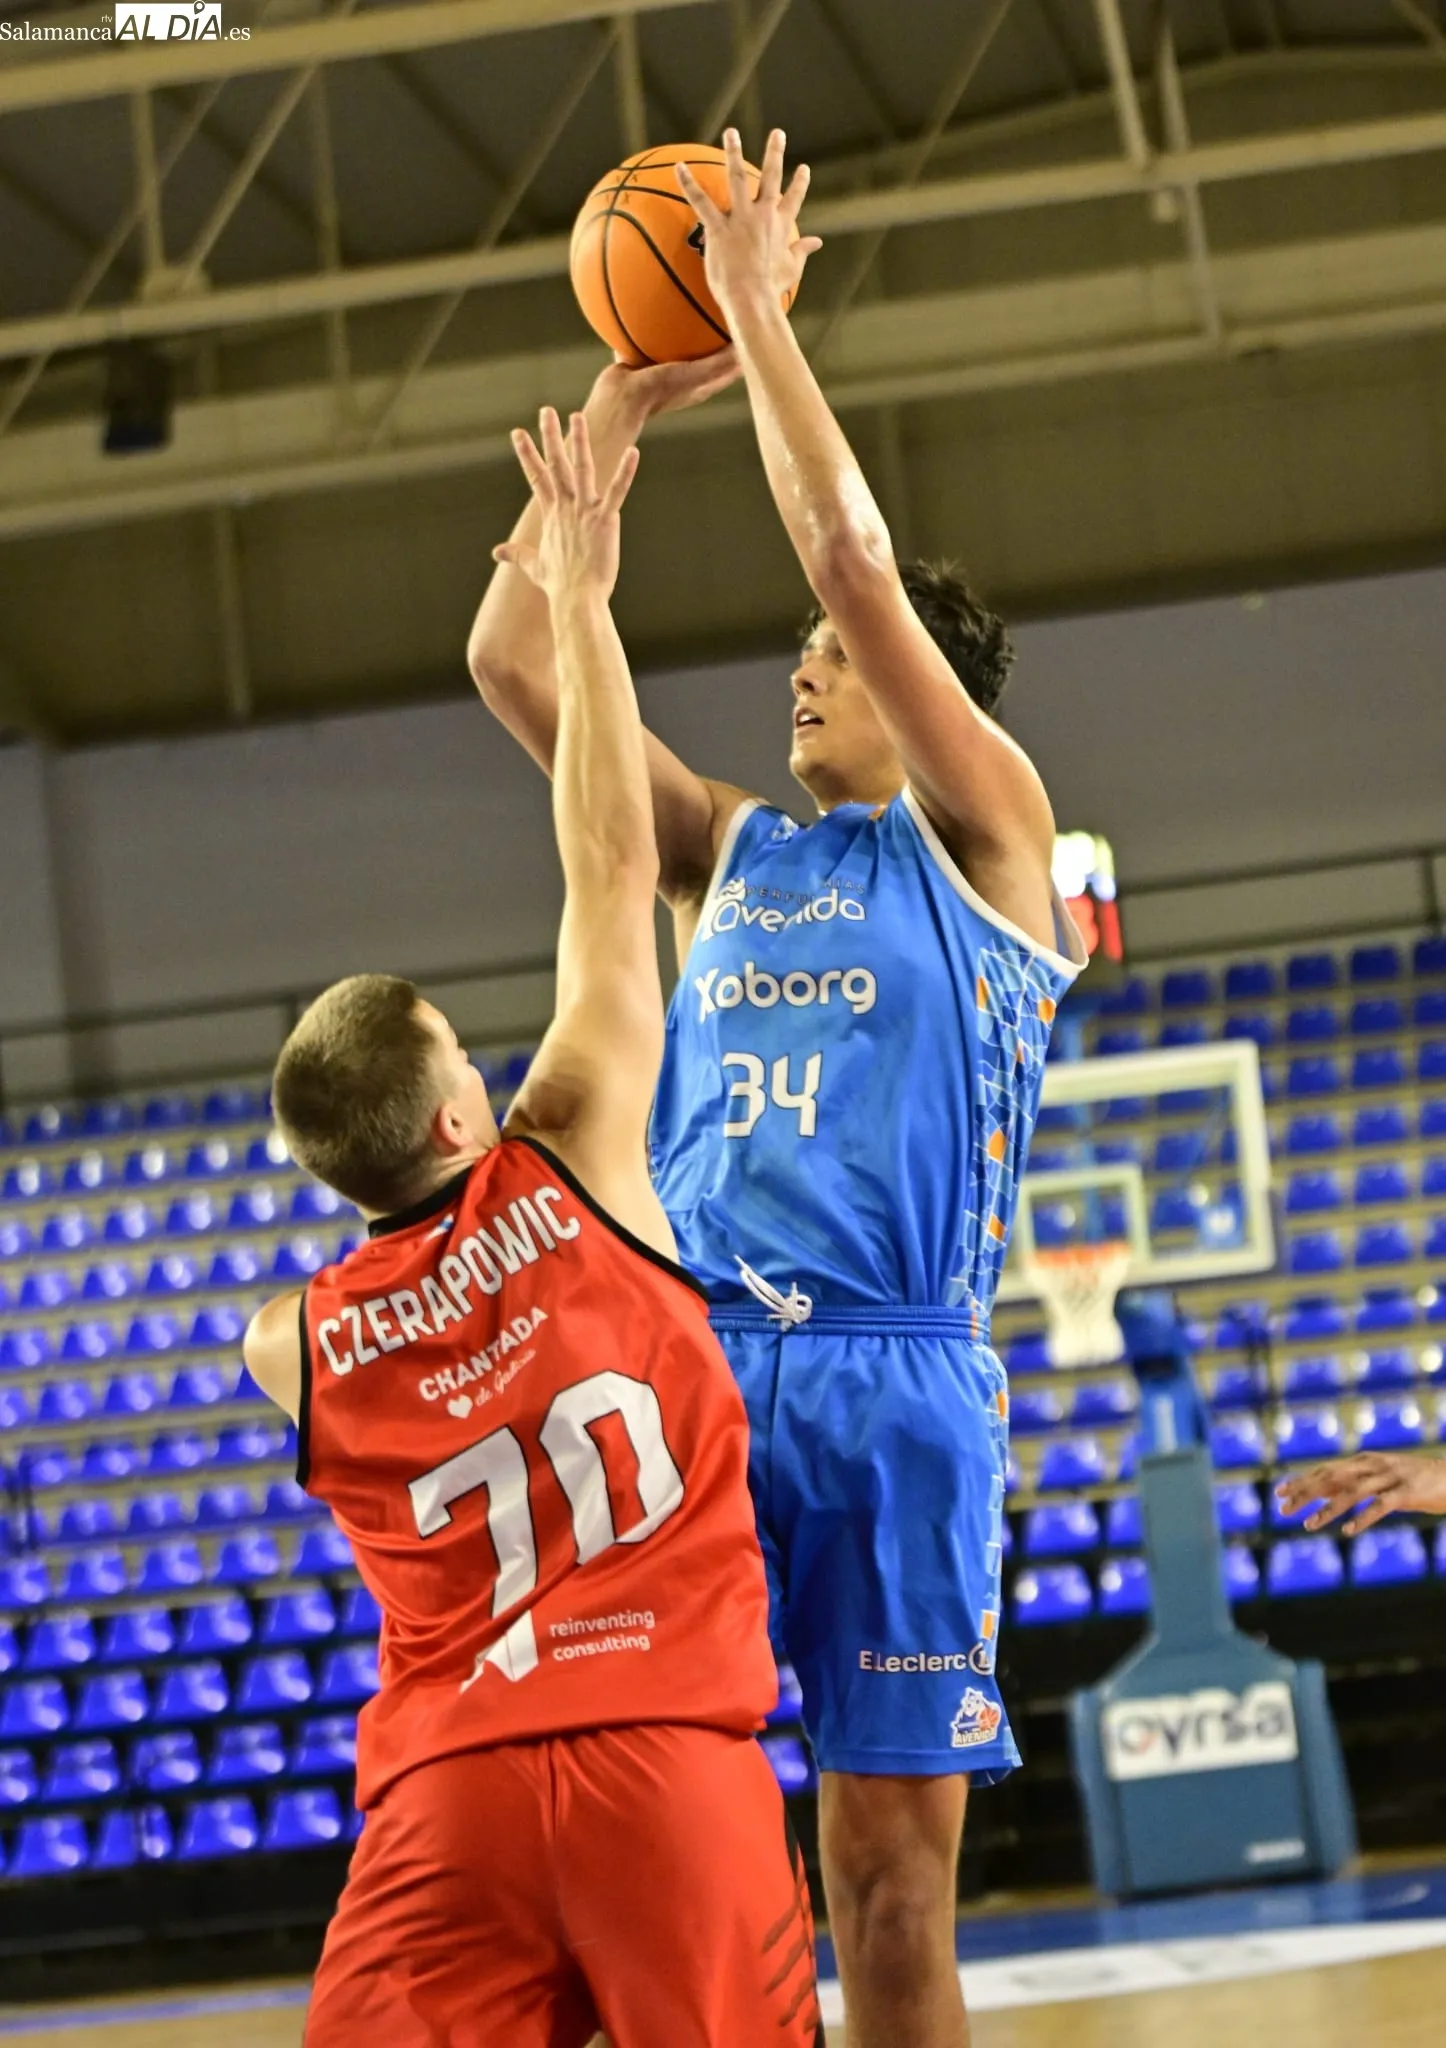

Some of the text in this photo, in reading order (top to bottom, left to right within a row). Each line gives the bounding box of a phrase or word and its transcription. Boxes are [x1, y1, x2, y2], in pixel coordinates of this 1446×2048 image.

[721, 1050, 823, 1139] 34
[317, 1185, 582, 1377] CZERAPOWIC
[418, 1306, 549, 1401] CHANTADA
[406, 1368, 686, 1688] 70
[549, 1610, 655, 1638] reinventing
[552, 1633, 650, 1662] consulting
